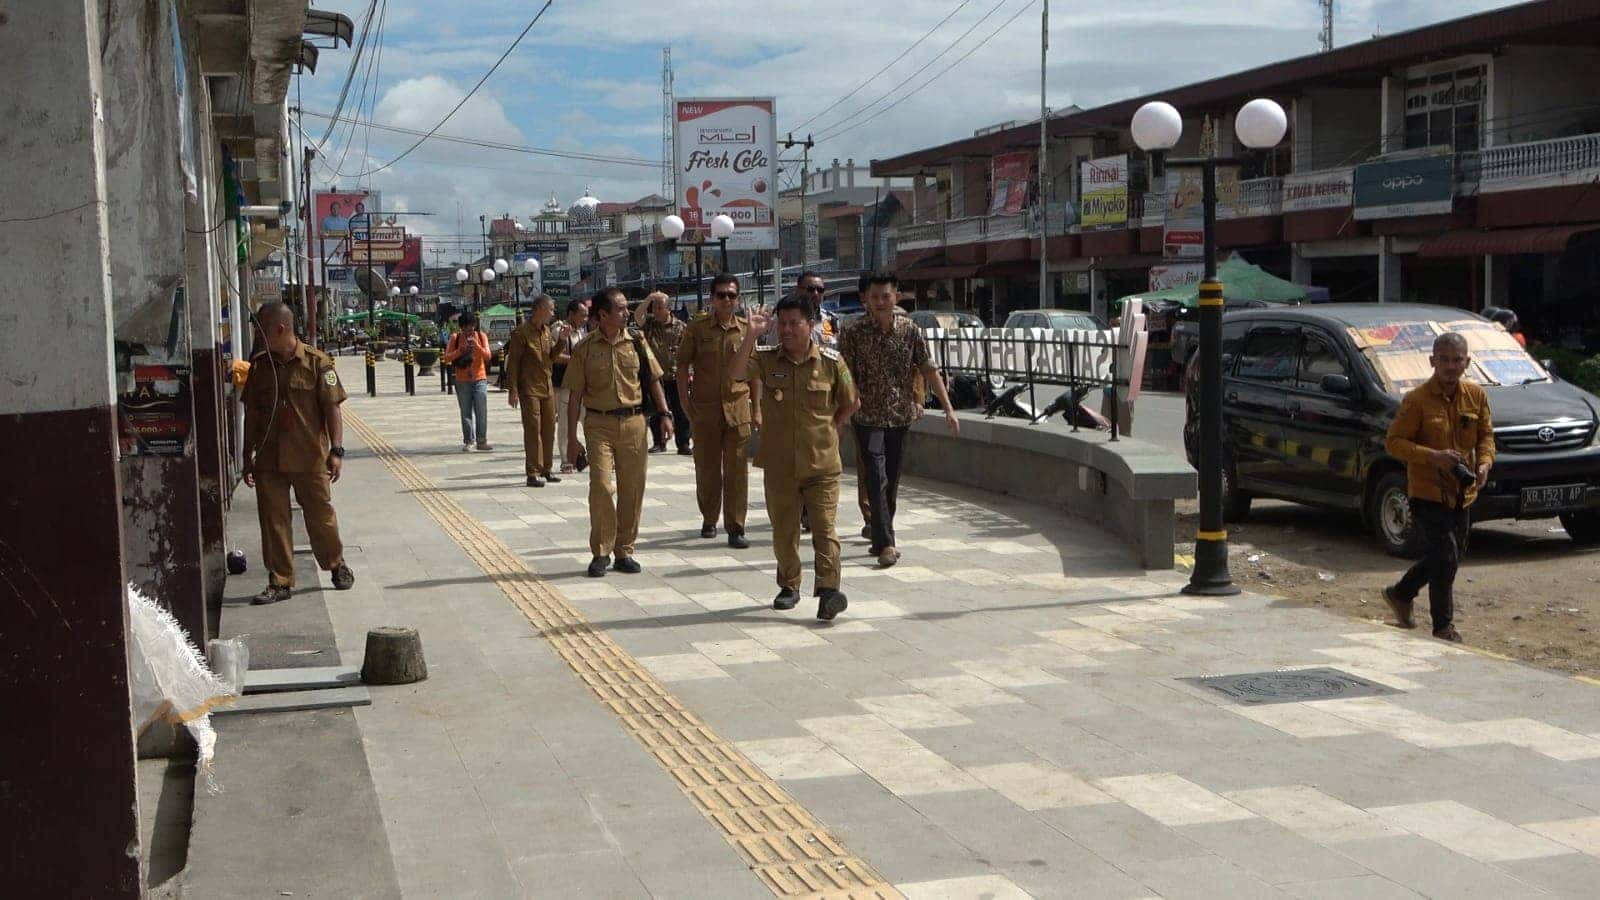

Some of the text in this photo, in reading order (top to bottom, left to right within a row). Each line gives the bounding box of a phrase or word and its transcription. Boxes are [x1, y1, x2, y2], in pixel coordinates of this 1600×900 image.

[681, 105, 703, 114] NEW
[684, 149, 769, 173] Fresh Cola
[1543, 488, 1564, 502] 1521
